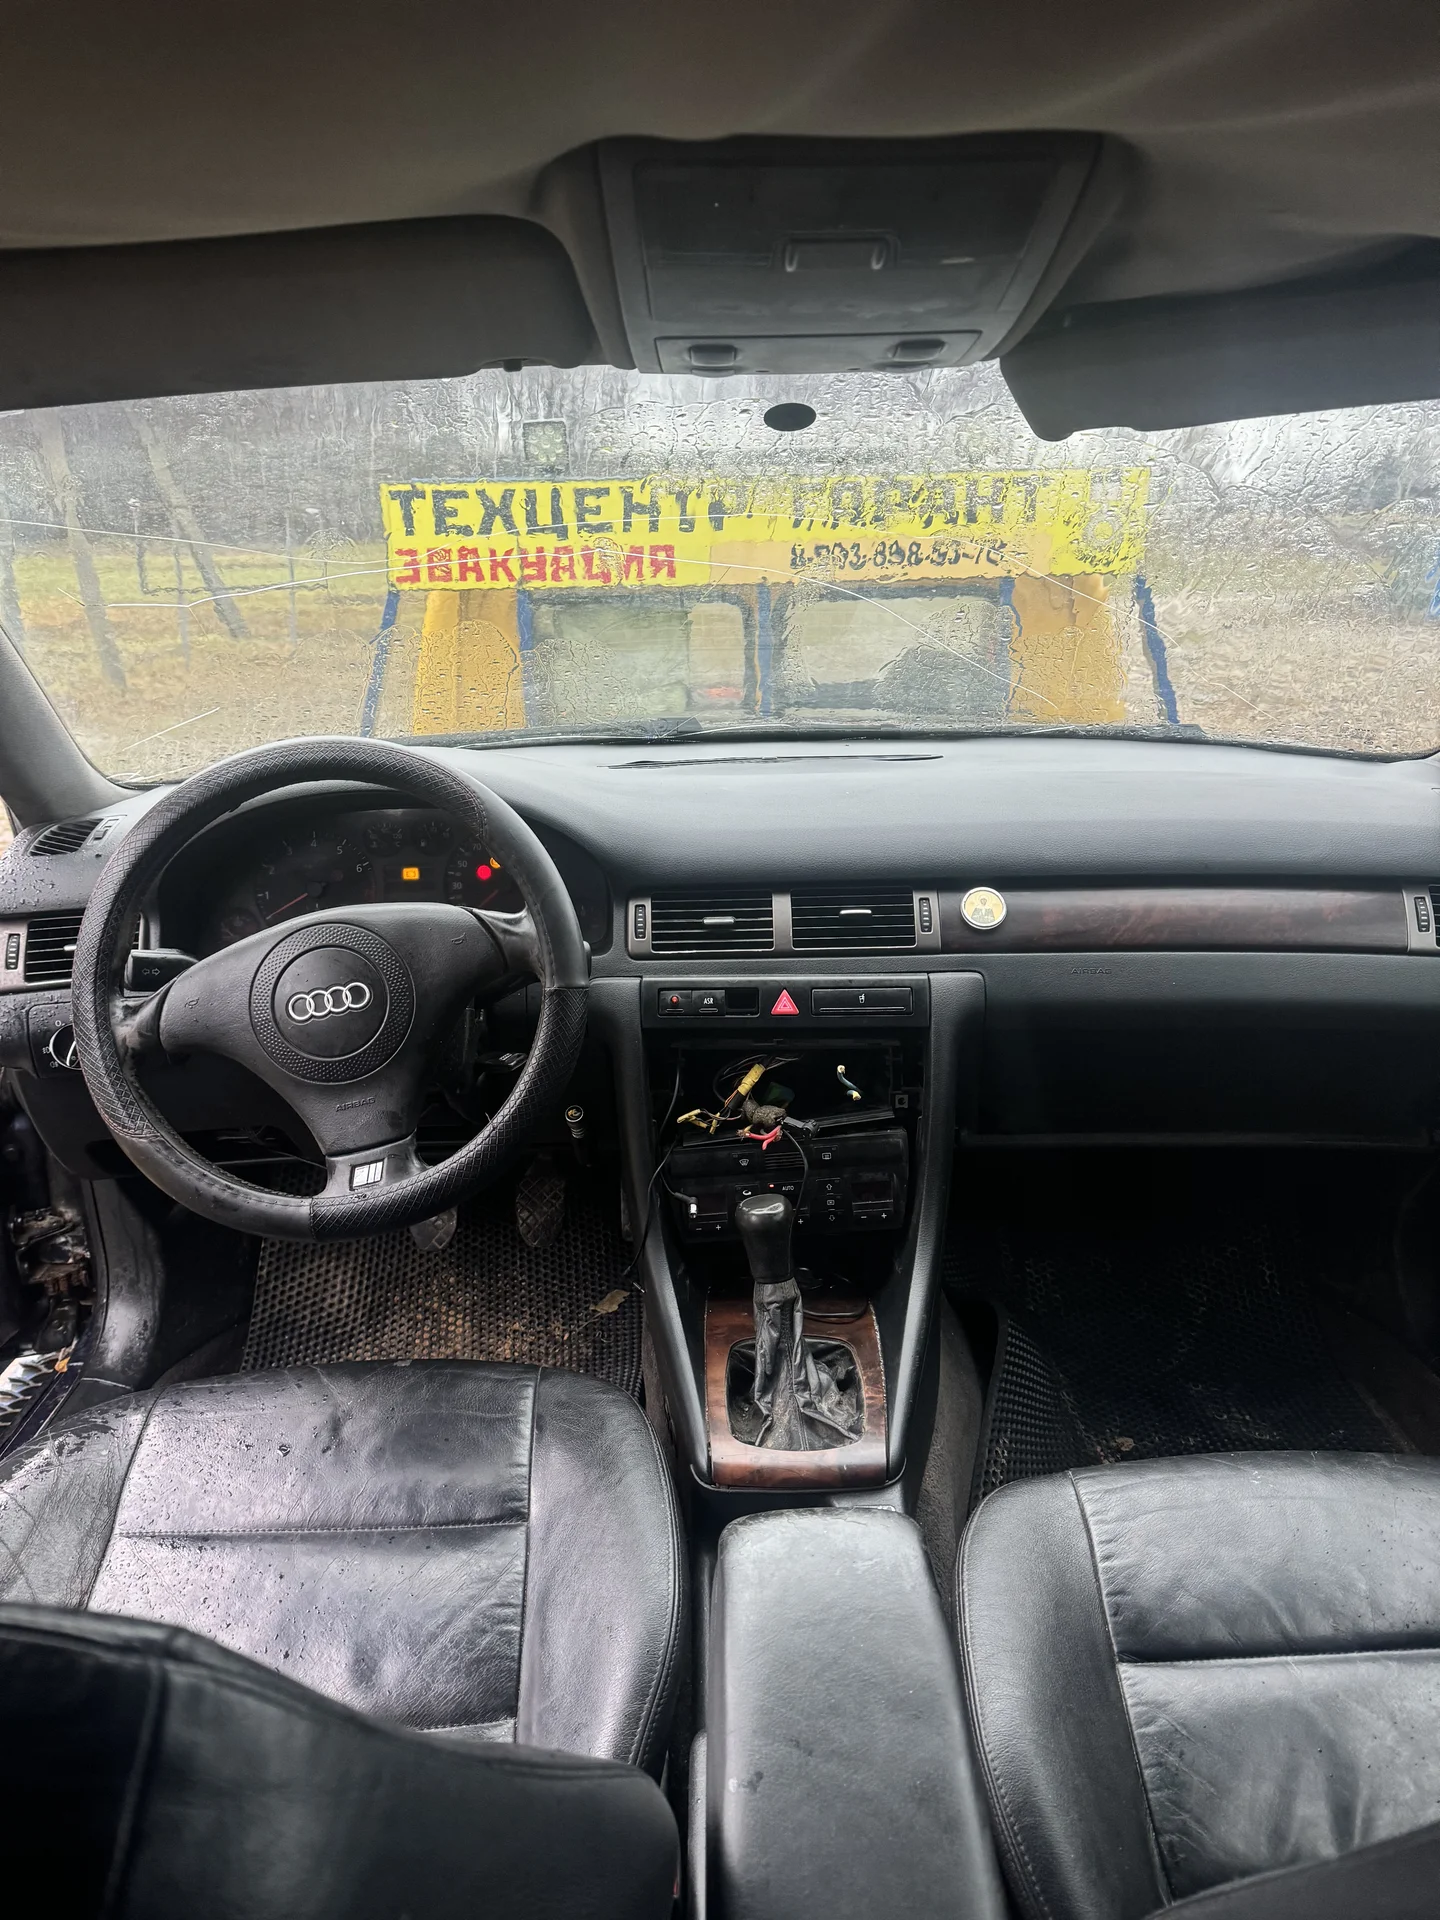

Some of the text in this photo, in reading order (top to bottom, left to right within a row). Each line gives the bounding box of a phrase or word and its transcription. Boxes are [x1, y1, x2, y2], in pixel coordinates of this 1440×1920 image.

[395, 544, 677, 584] ЭВАКУАЦИЯ
[703, 997, 714, 1006] ASR
[335, 1095, 377, 1113] AIRBAG
